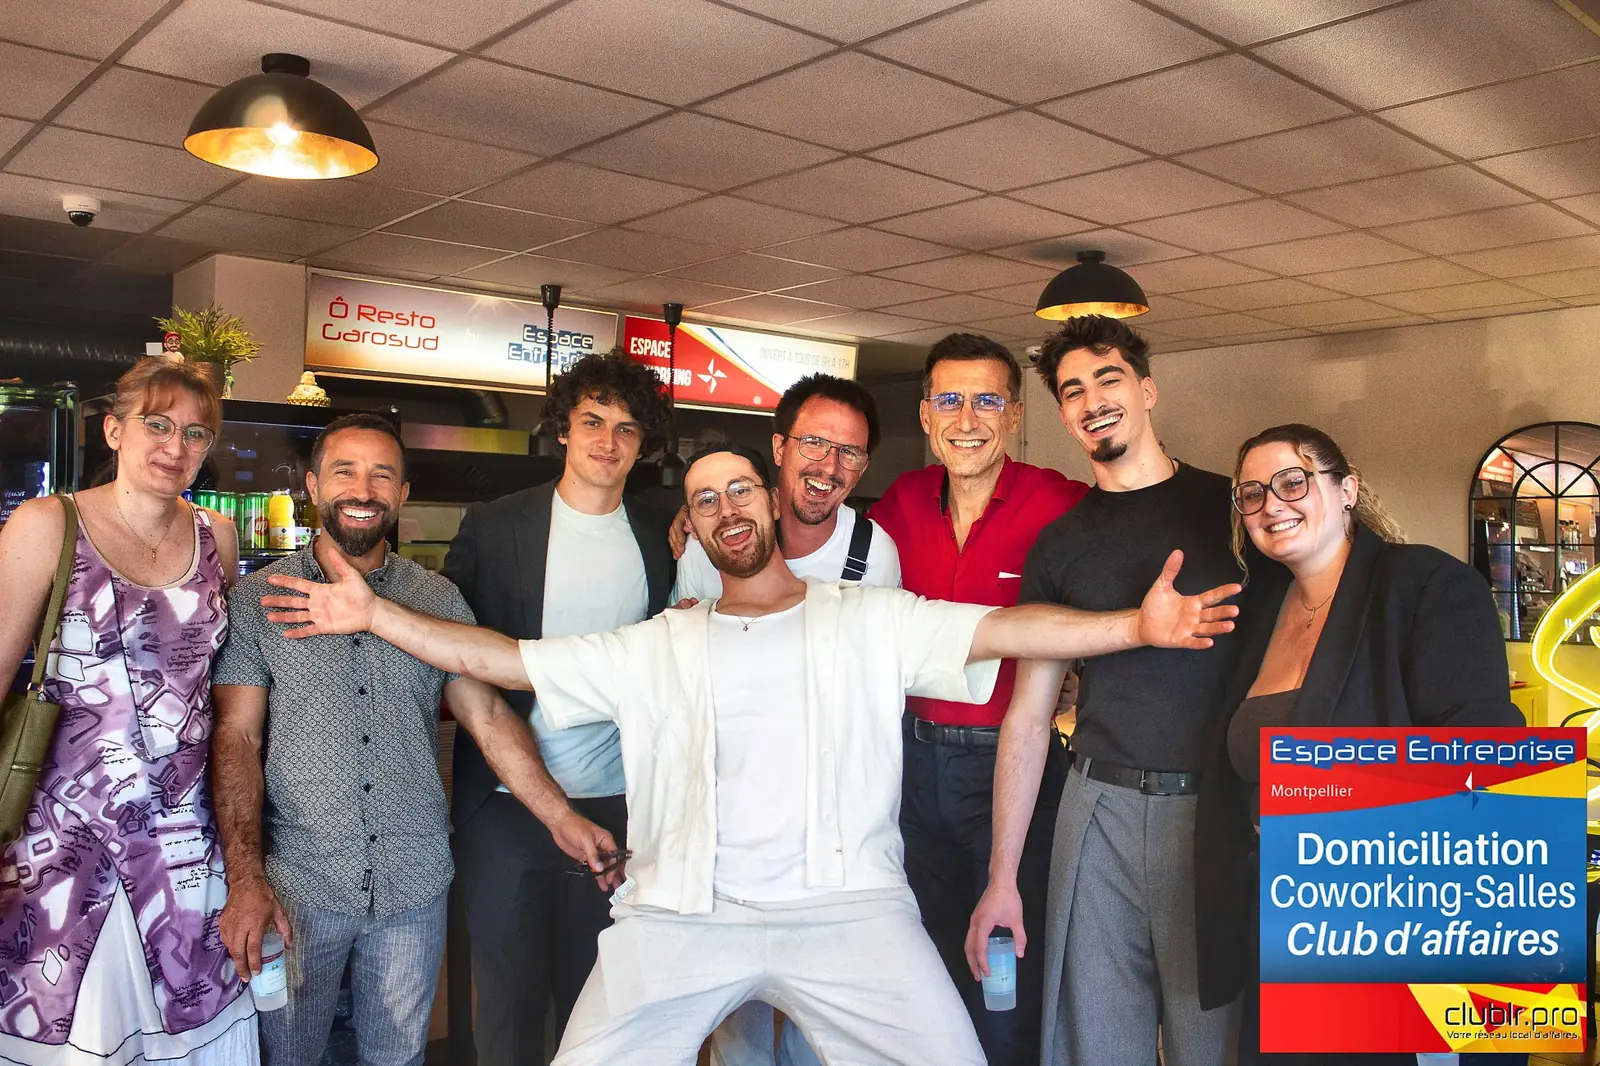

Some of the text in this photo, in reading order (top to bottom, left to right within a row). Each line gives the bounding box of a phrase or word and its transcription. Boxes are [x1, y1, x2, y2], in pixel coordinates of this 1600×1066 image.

[329, 296, 436, 329] Ô Resto
[322, 323, 439, 351] Garosud
[523, 326, 594, 349] Espace
[630, 336, 672, 359] ESPACE
[508, 345, 581, 366] Entrepr
[760, 347, 787, 361] OUVERT
[795, 352, 811, 365] TOUS
[811, 354, 820, 367] DE
[838, 358, 850, 371] 17H
